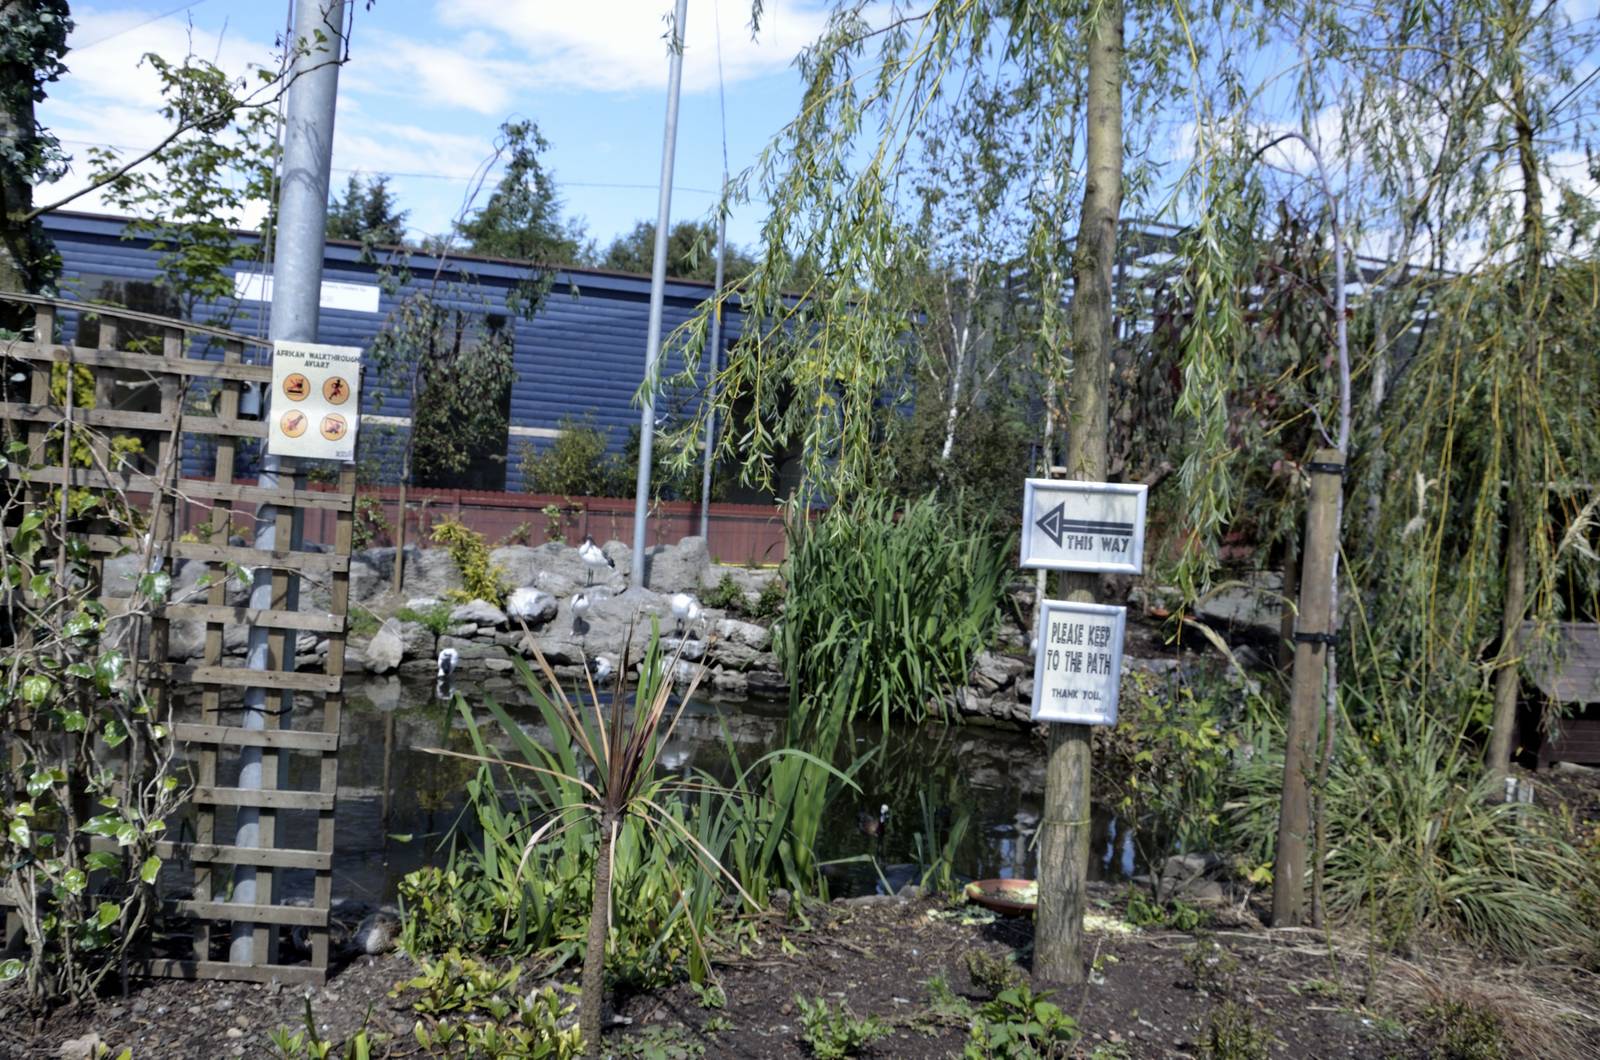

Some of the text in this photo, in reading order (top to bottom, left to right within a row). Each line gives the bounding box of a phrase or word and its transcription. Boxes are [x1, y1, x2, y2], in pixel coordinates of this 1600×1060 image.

[276, 349, 361, 363] AFRICAN WALKTHROUGH
[304, 360, 330, 369] AVIARY
[1067, 535, 1130, 553] THIS WAY
[1051, 622, 1111, 648] PLEASE KEEP
[1047, 649, 1112, 675] TO THE PATH
[1051, 688, 1078, 700] THANK
